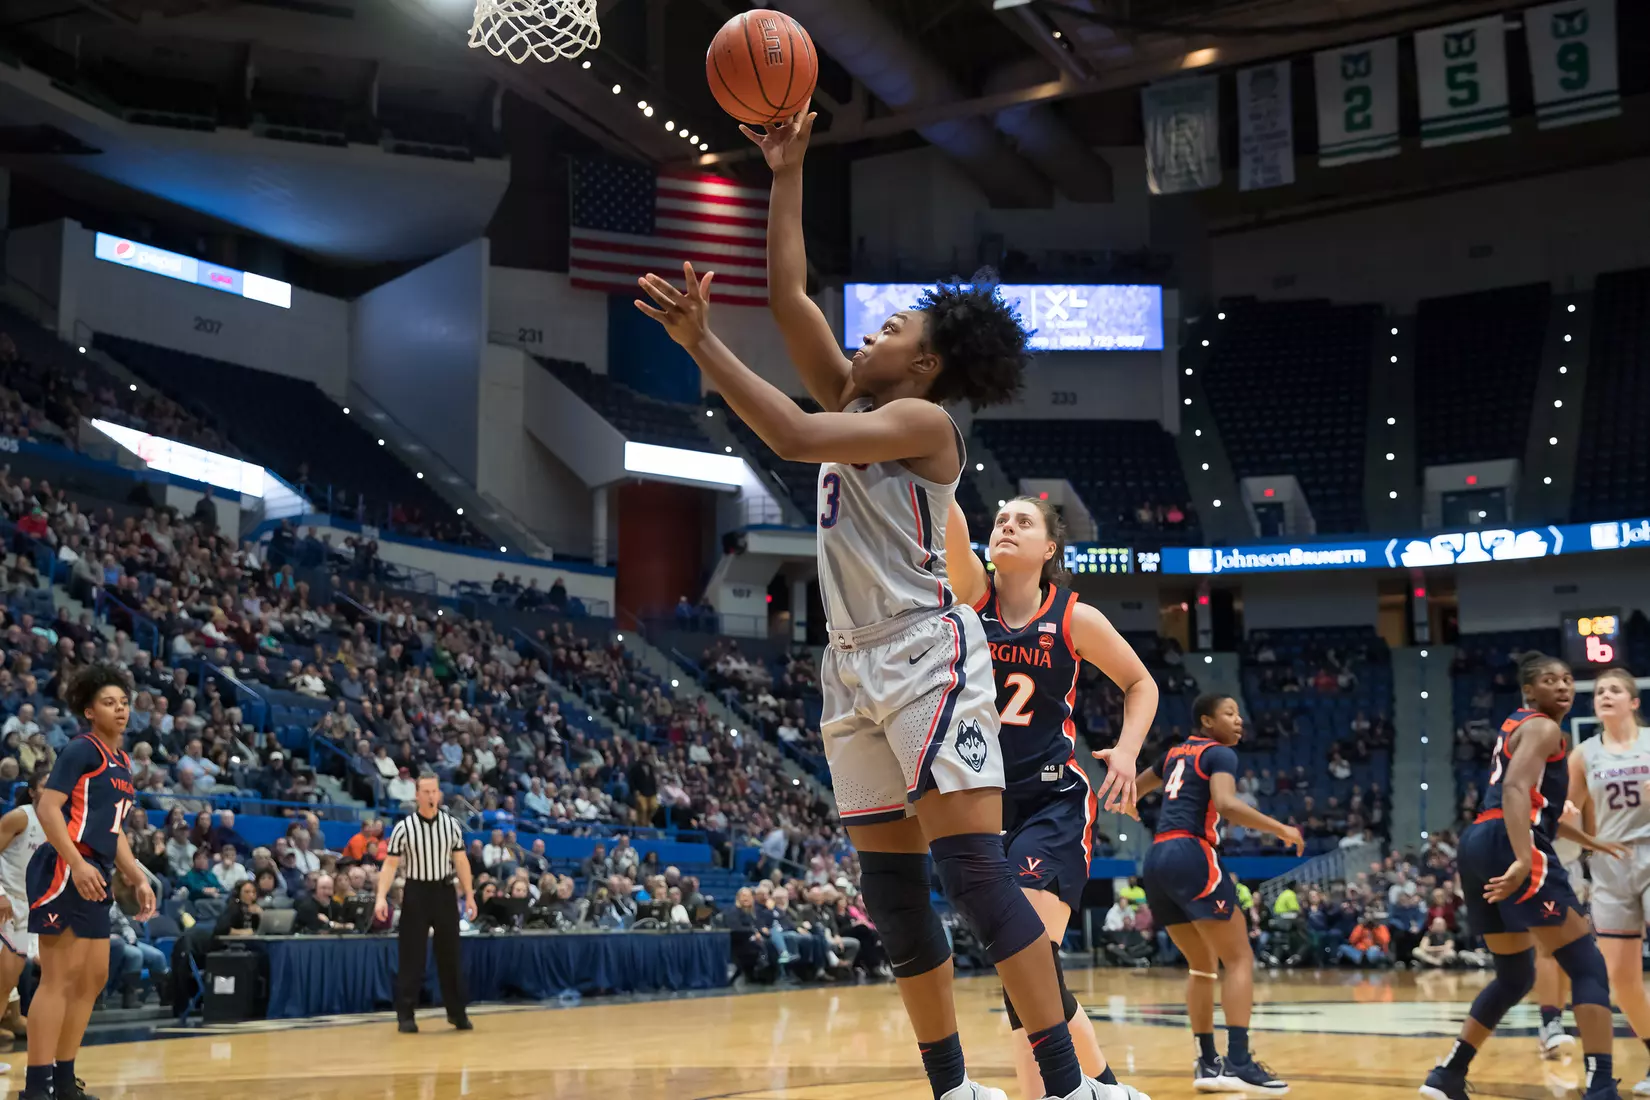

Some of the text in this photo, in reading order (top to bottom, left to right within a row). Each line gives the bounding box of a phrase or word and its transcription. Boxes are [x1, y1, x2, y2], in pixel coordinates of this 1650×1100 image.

[1556, 41, 1590, 92] 9
[1446, 62, 1480, 108] 5
[1344, 85, 1373, 133] 2
[1045, 290, 1088, 321] XL
[194, 316, 223, 335] 207
[518, 327, 543, 343] 231
[1051, 391, 1077, 405] 233
[820, 472, 841, 529] 3
[987, 641, 1052, 669] RGINIA
[993, 668, 1036, 727] 2
[1043, 764, 1056, 772] 46
[1165, 757, 1185, 800] 4
[1605, 780, 1641, 810] 25
